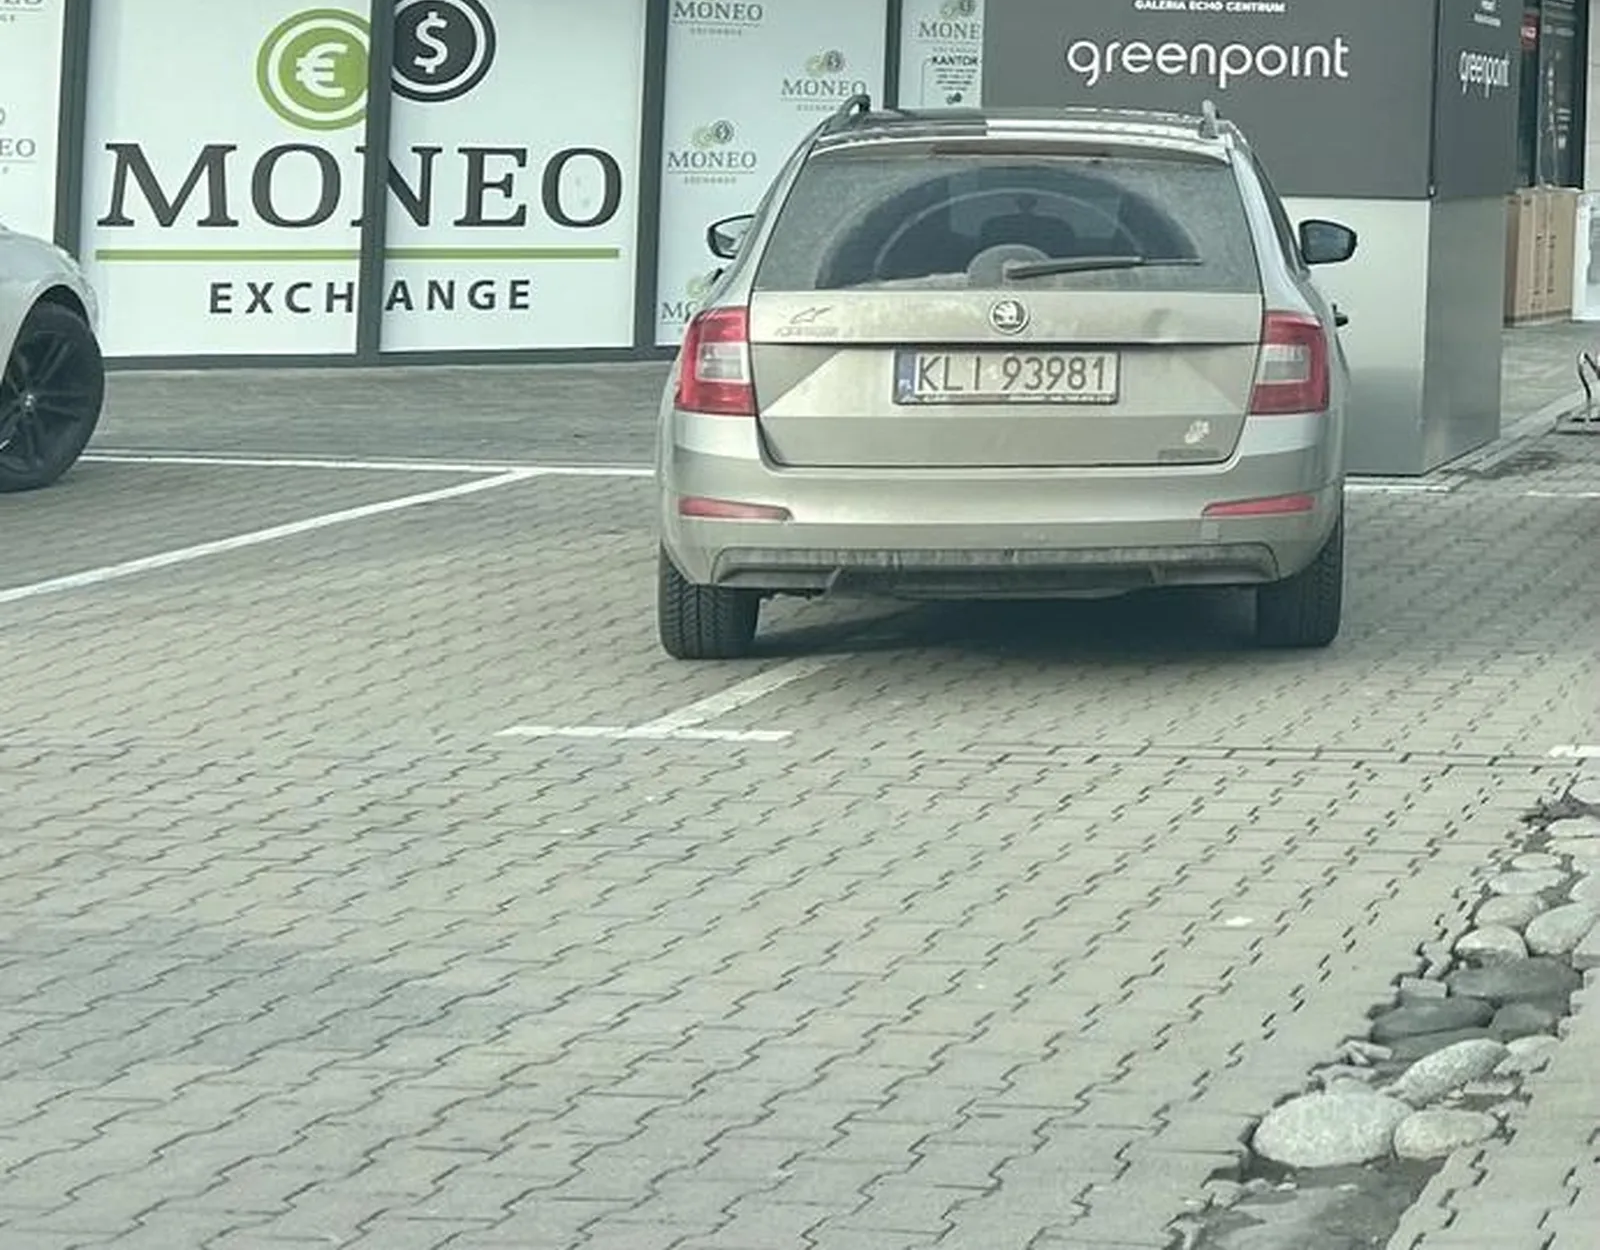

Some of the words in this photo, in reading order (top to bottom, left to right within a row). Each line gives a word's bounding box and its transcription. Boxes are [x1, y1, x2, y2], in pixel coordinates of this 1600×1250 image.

[673, 1, 763, 21] MONEO
[1134, 0, 1187, 10] GALERIA
[1226, 1, 1286, 12] CENTRUM
[918, 21, 979, 39] MONE
[1067, 37, 1349, 89] greenpoint
[781, 79, 867, 97] MONEO
[667, 151, 757, 169] MONEO
[96, 142, 623, 229] MONEO
[209, 279, 531, 314] EXCHANGE
[917, 356, 981, 391] KLI
[1001, 355, 1105, 391] 93981
